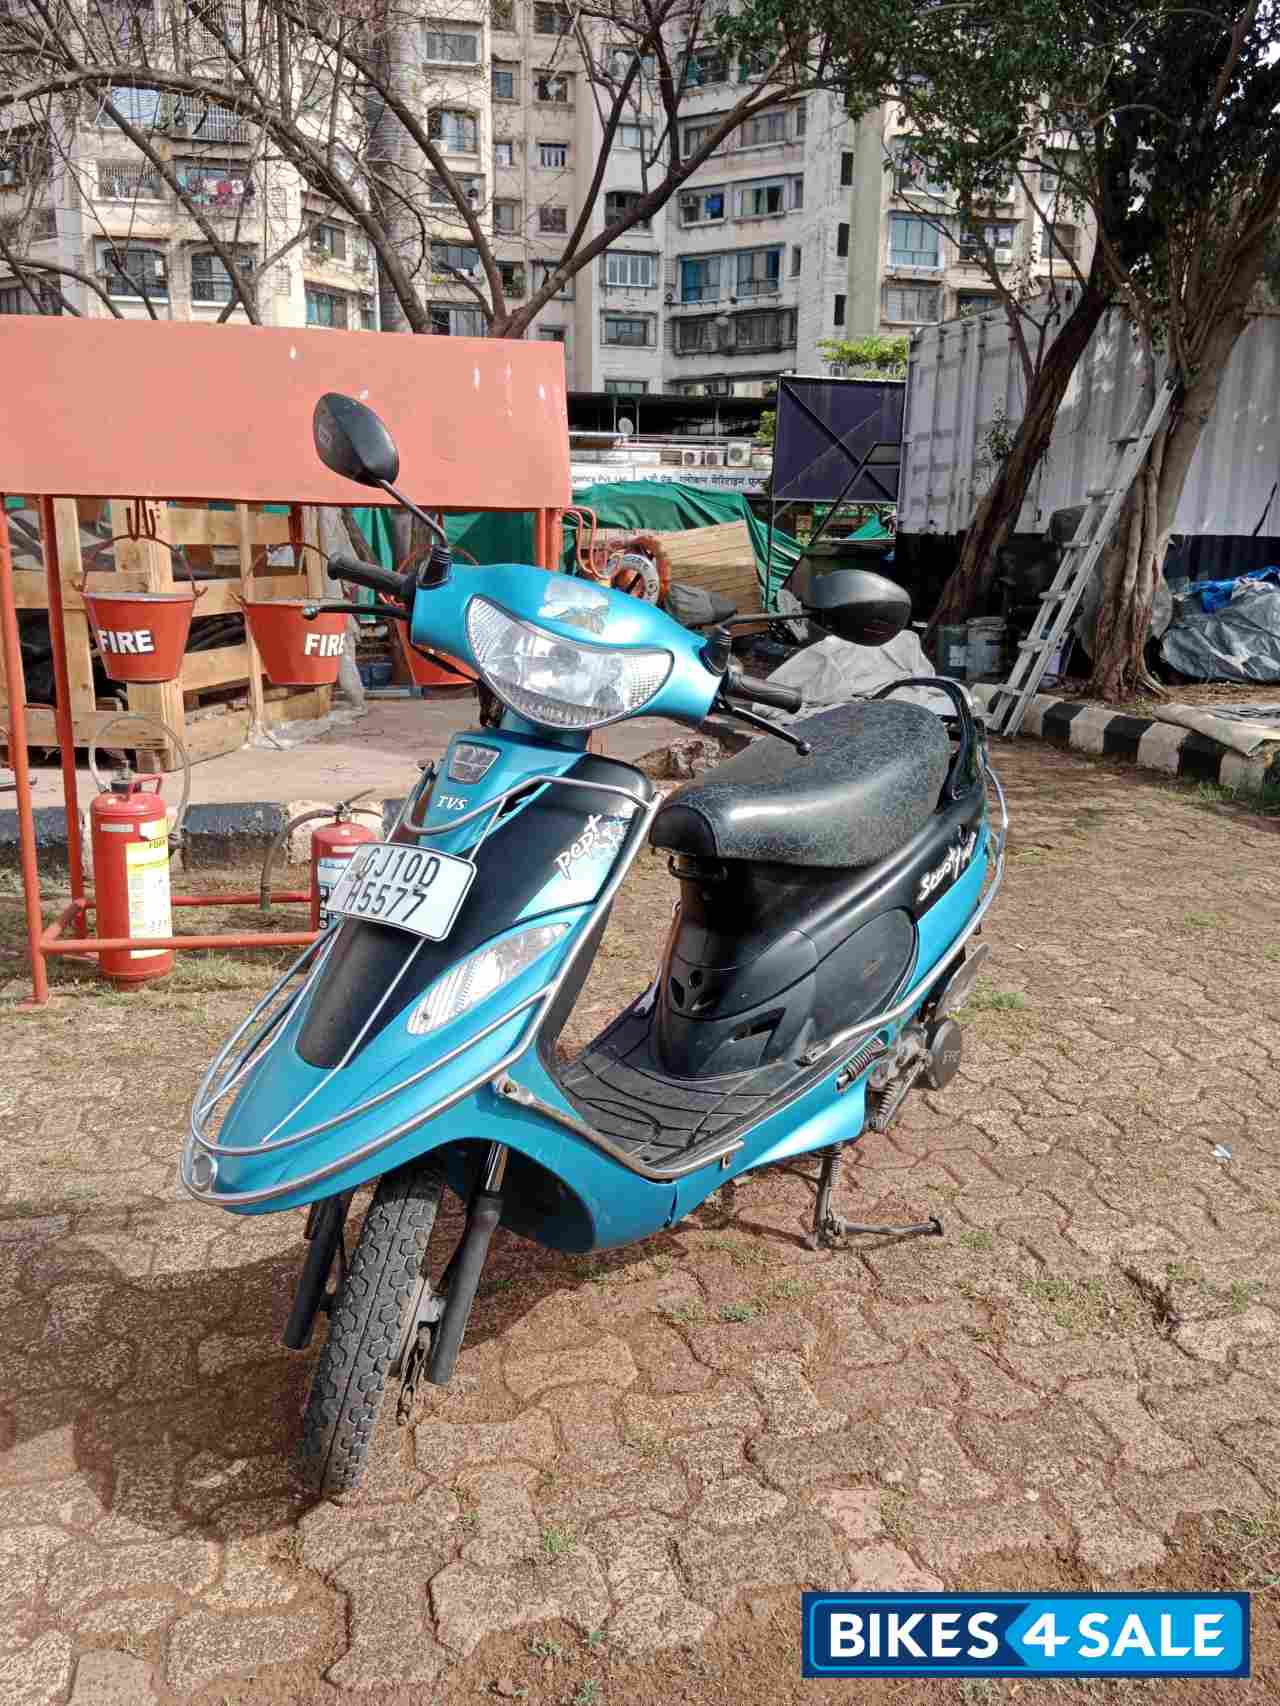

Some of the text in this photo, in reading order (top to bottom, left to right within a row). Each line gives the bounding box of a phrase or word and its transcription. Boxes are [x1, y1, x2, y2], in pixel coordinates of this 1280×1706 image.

[98, 629, 154, 653] FIRE
[436, 795, 469, 810] TVS
[355, 847, 441, 888] GJ10D
